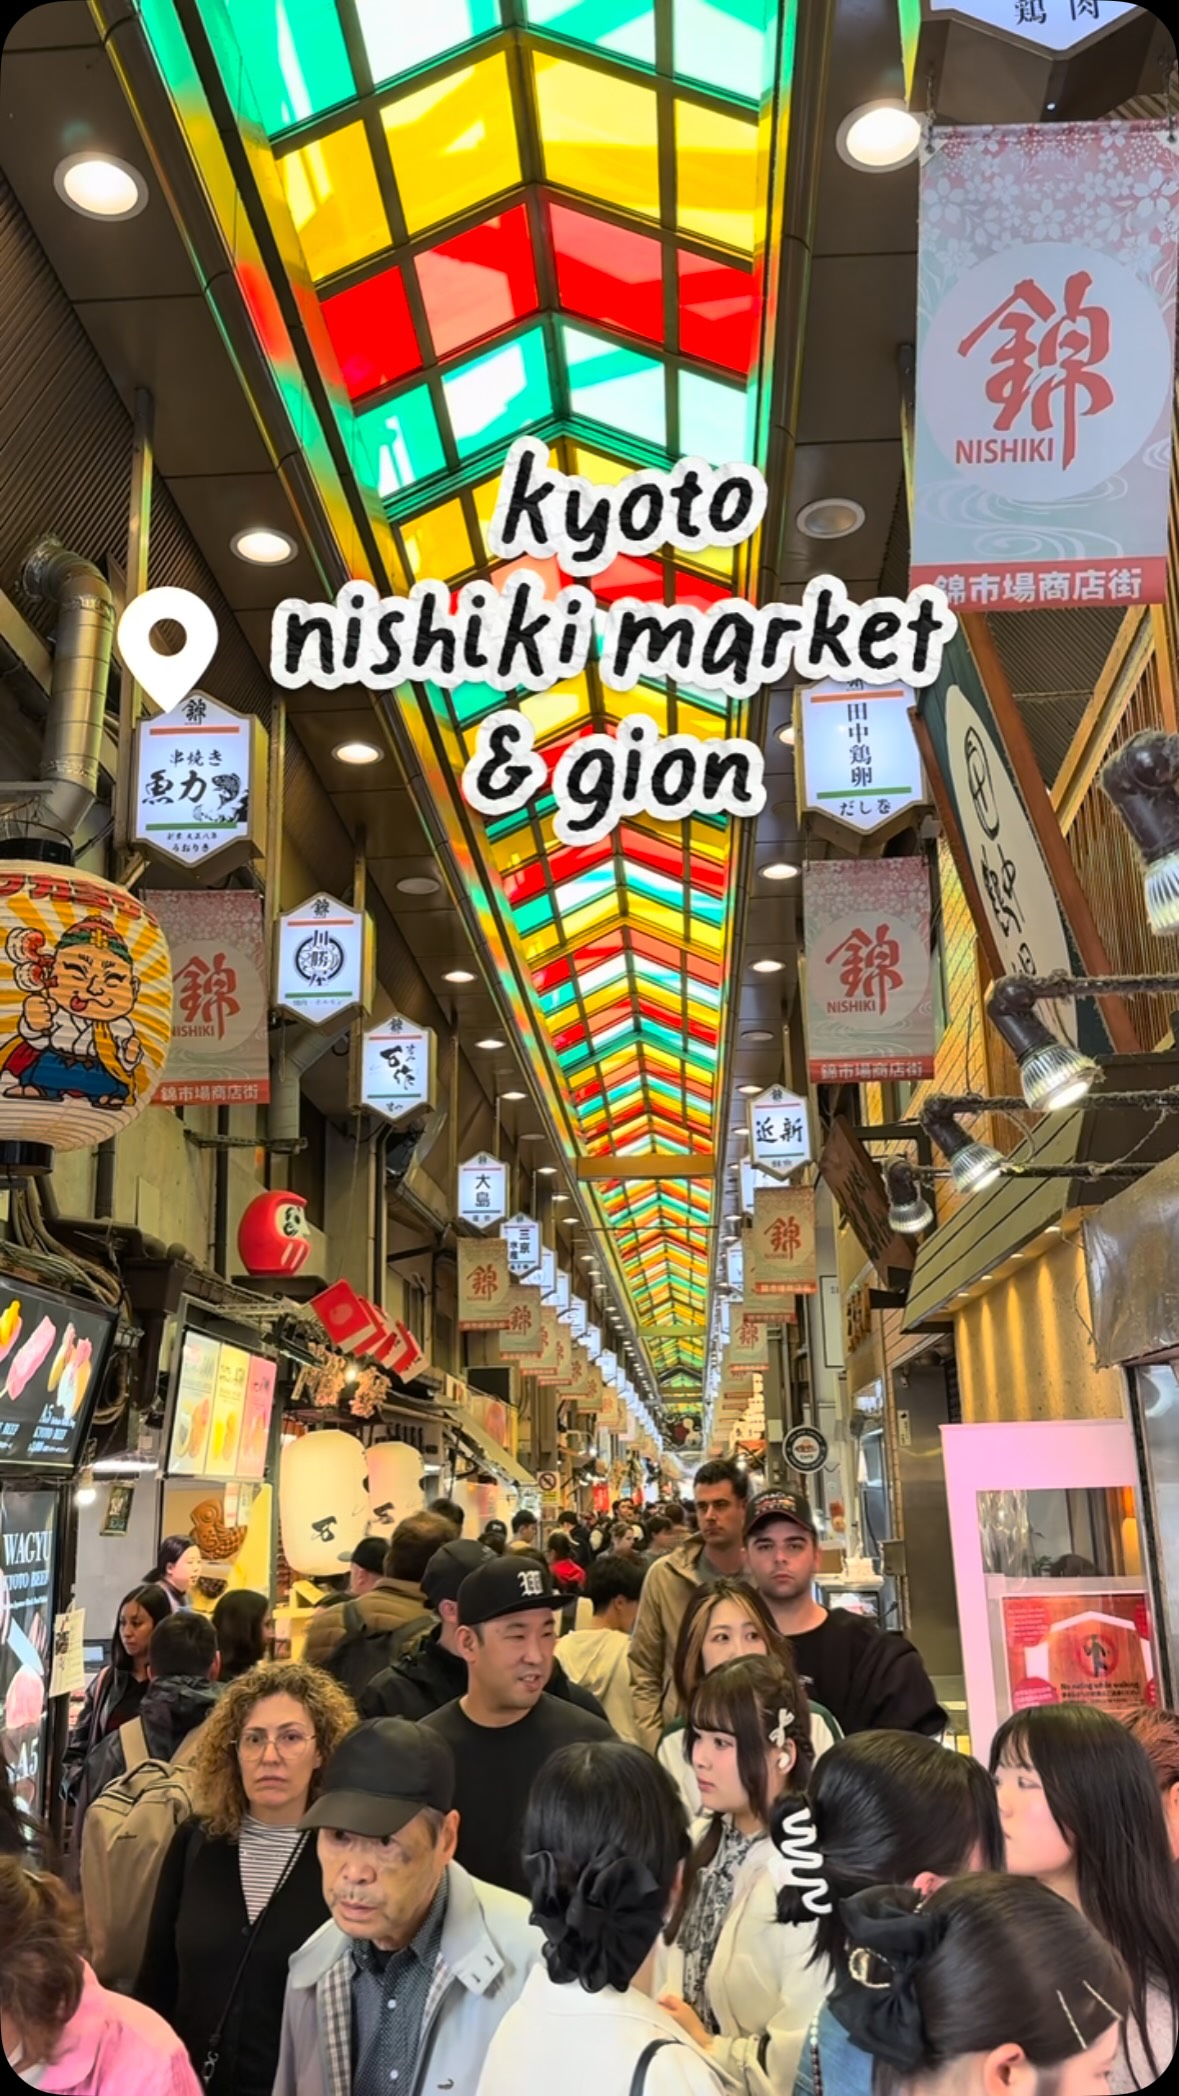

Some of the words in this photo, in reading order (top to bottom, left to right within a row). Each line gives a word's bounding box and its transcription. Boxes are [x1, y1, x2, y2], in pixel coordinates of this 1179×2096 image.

[957, 271, 1114, 470] 錦
[955, 438, 1054, 464] NISHIKI
[934, 567, 1142, 605] 錦市場商店街
[170, 749, 223, 767] 串焼き
[847, 702, 873, 787] 田中鶏卵
[840, 799, 891, 816] だし巻
[825, 923, 903, 1016] 錦
[172, 952, 240, 1040] 錦
[827, 1000, 876, 1013] NISHIKI
[475, 1174, 491, 1208] 大島
[3, 1530, 52, 1566] WAGYU
